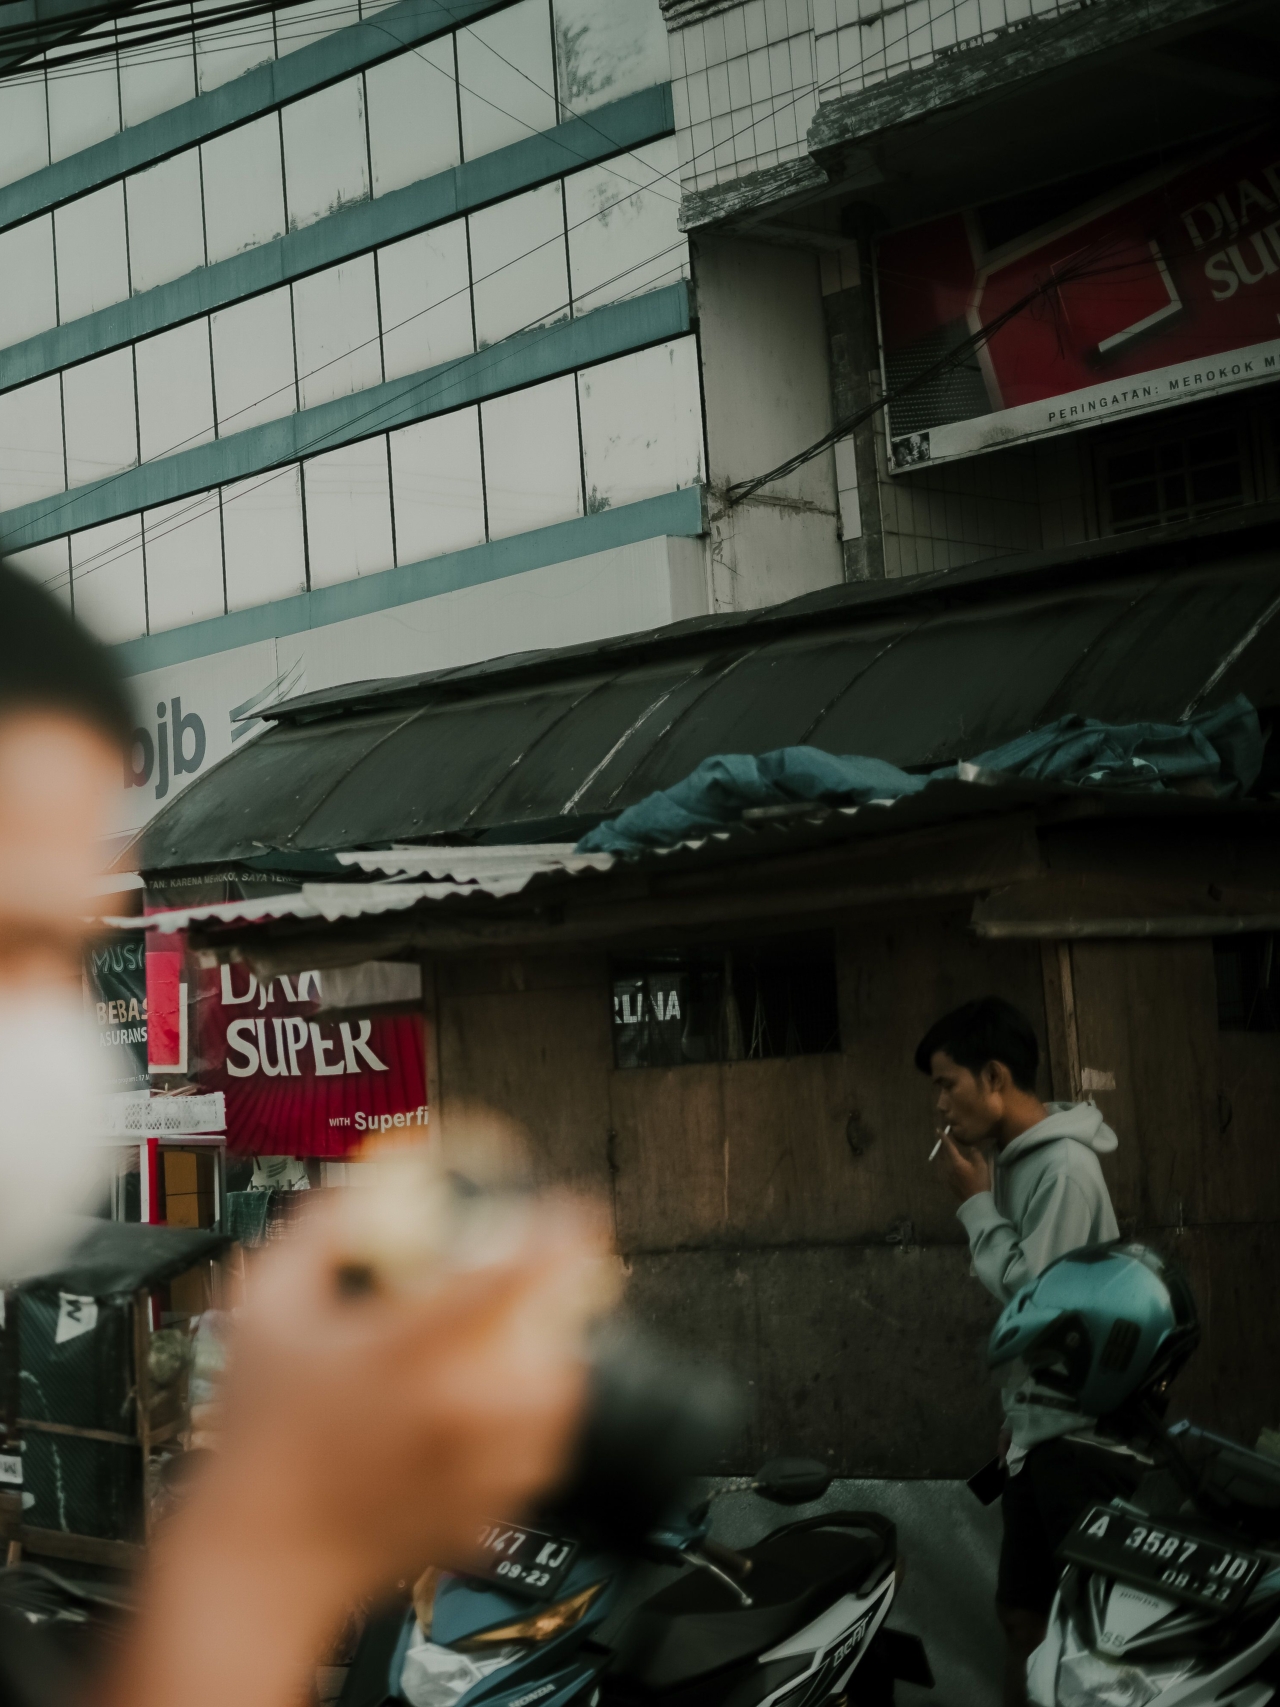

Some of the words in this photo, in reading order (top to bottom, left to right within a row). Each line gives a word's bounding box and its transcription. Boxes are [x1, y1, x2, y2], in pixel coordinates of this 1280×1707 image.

[1048, 385, 1160, 422] PERINGATAN:
[1169, 359, 1255, 391] MEROKOK
[122, 696, 207, 800] bjb
[170, 877, 202, 888] KARENA
[241, 872, 267, 882] SAYA
[226, 1016, 390, 1078] SUPER
[329, 1117, 351, 1127] WITH
[354, 1105, 429, 1133] Superfi
[1087, 1515, 1111, 1538] A
[1124, 1526, 1199, 1564] 3587
[1209, 1553, 1250, 1580] JD
